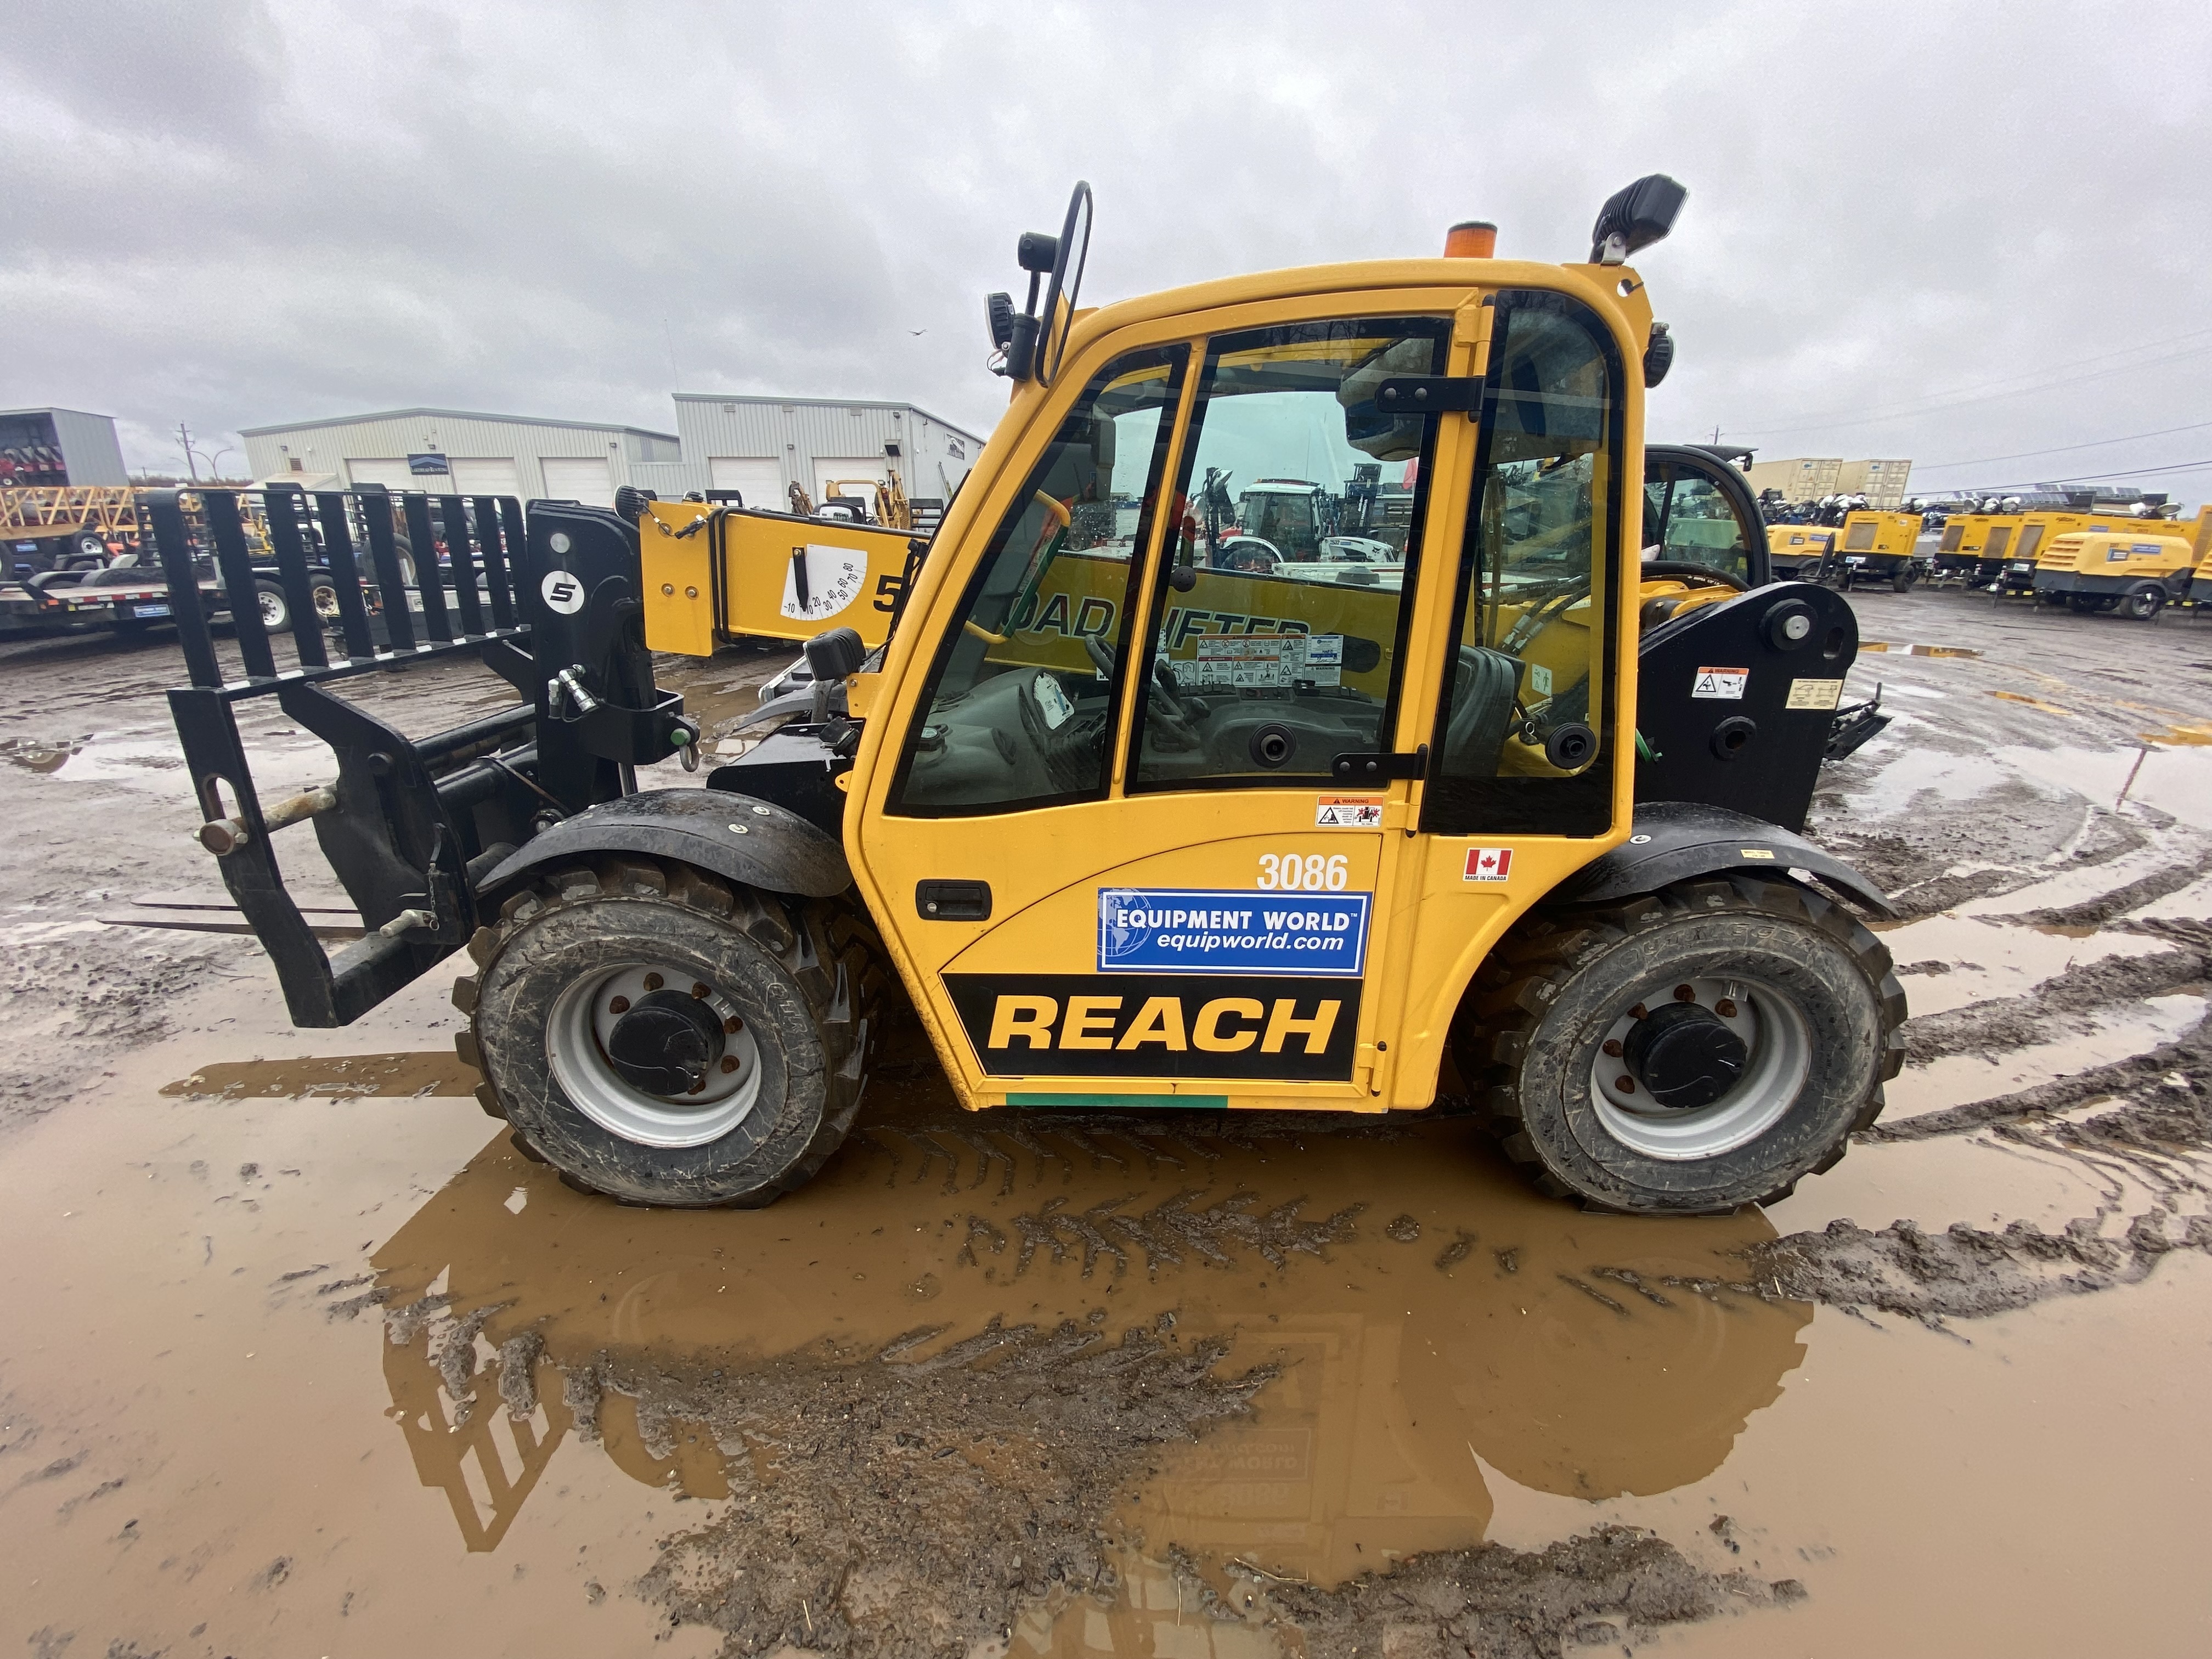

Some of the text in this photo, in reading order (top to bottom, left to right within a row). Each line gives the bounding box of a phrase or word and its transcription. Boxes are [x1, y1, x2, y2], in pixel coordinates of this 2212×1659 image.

[843, 563, 854, 572] 80
[837, 578, 848, 588] 60
[847, 573, 858, 583] 70
[827, 589, 837, 600] 40
[837, 589, 848, 600] 50
[812, 596, 821, 607] 20
[823, 600, 833, 611] 30
[783, 602, 795, 613] -10
[806, 605, 814, 615] 10
[1257, 854, 1348, 891] 3086
[1116, 909, 1252, 930] EQUIPMENT
[1156, 931, 1345, 953] equipworld.com
[987, 995, 1342, 1054] REACH
